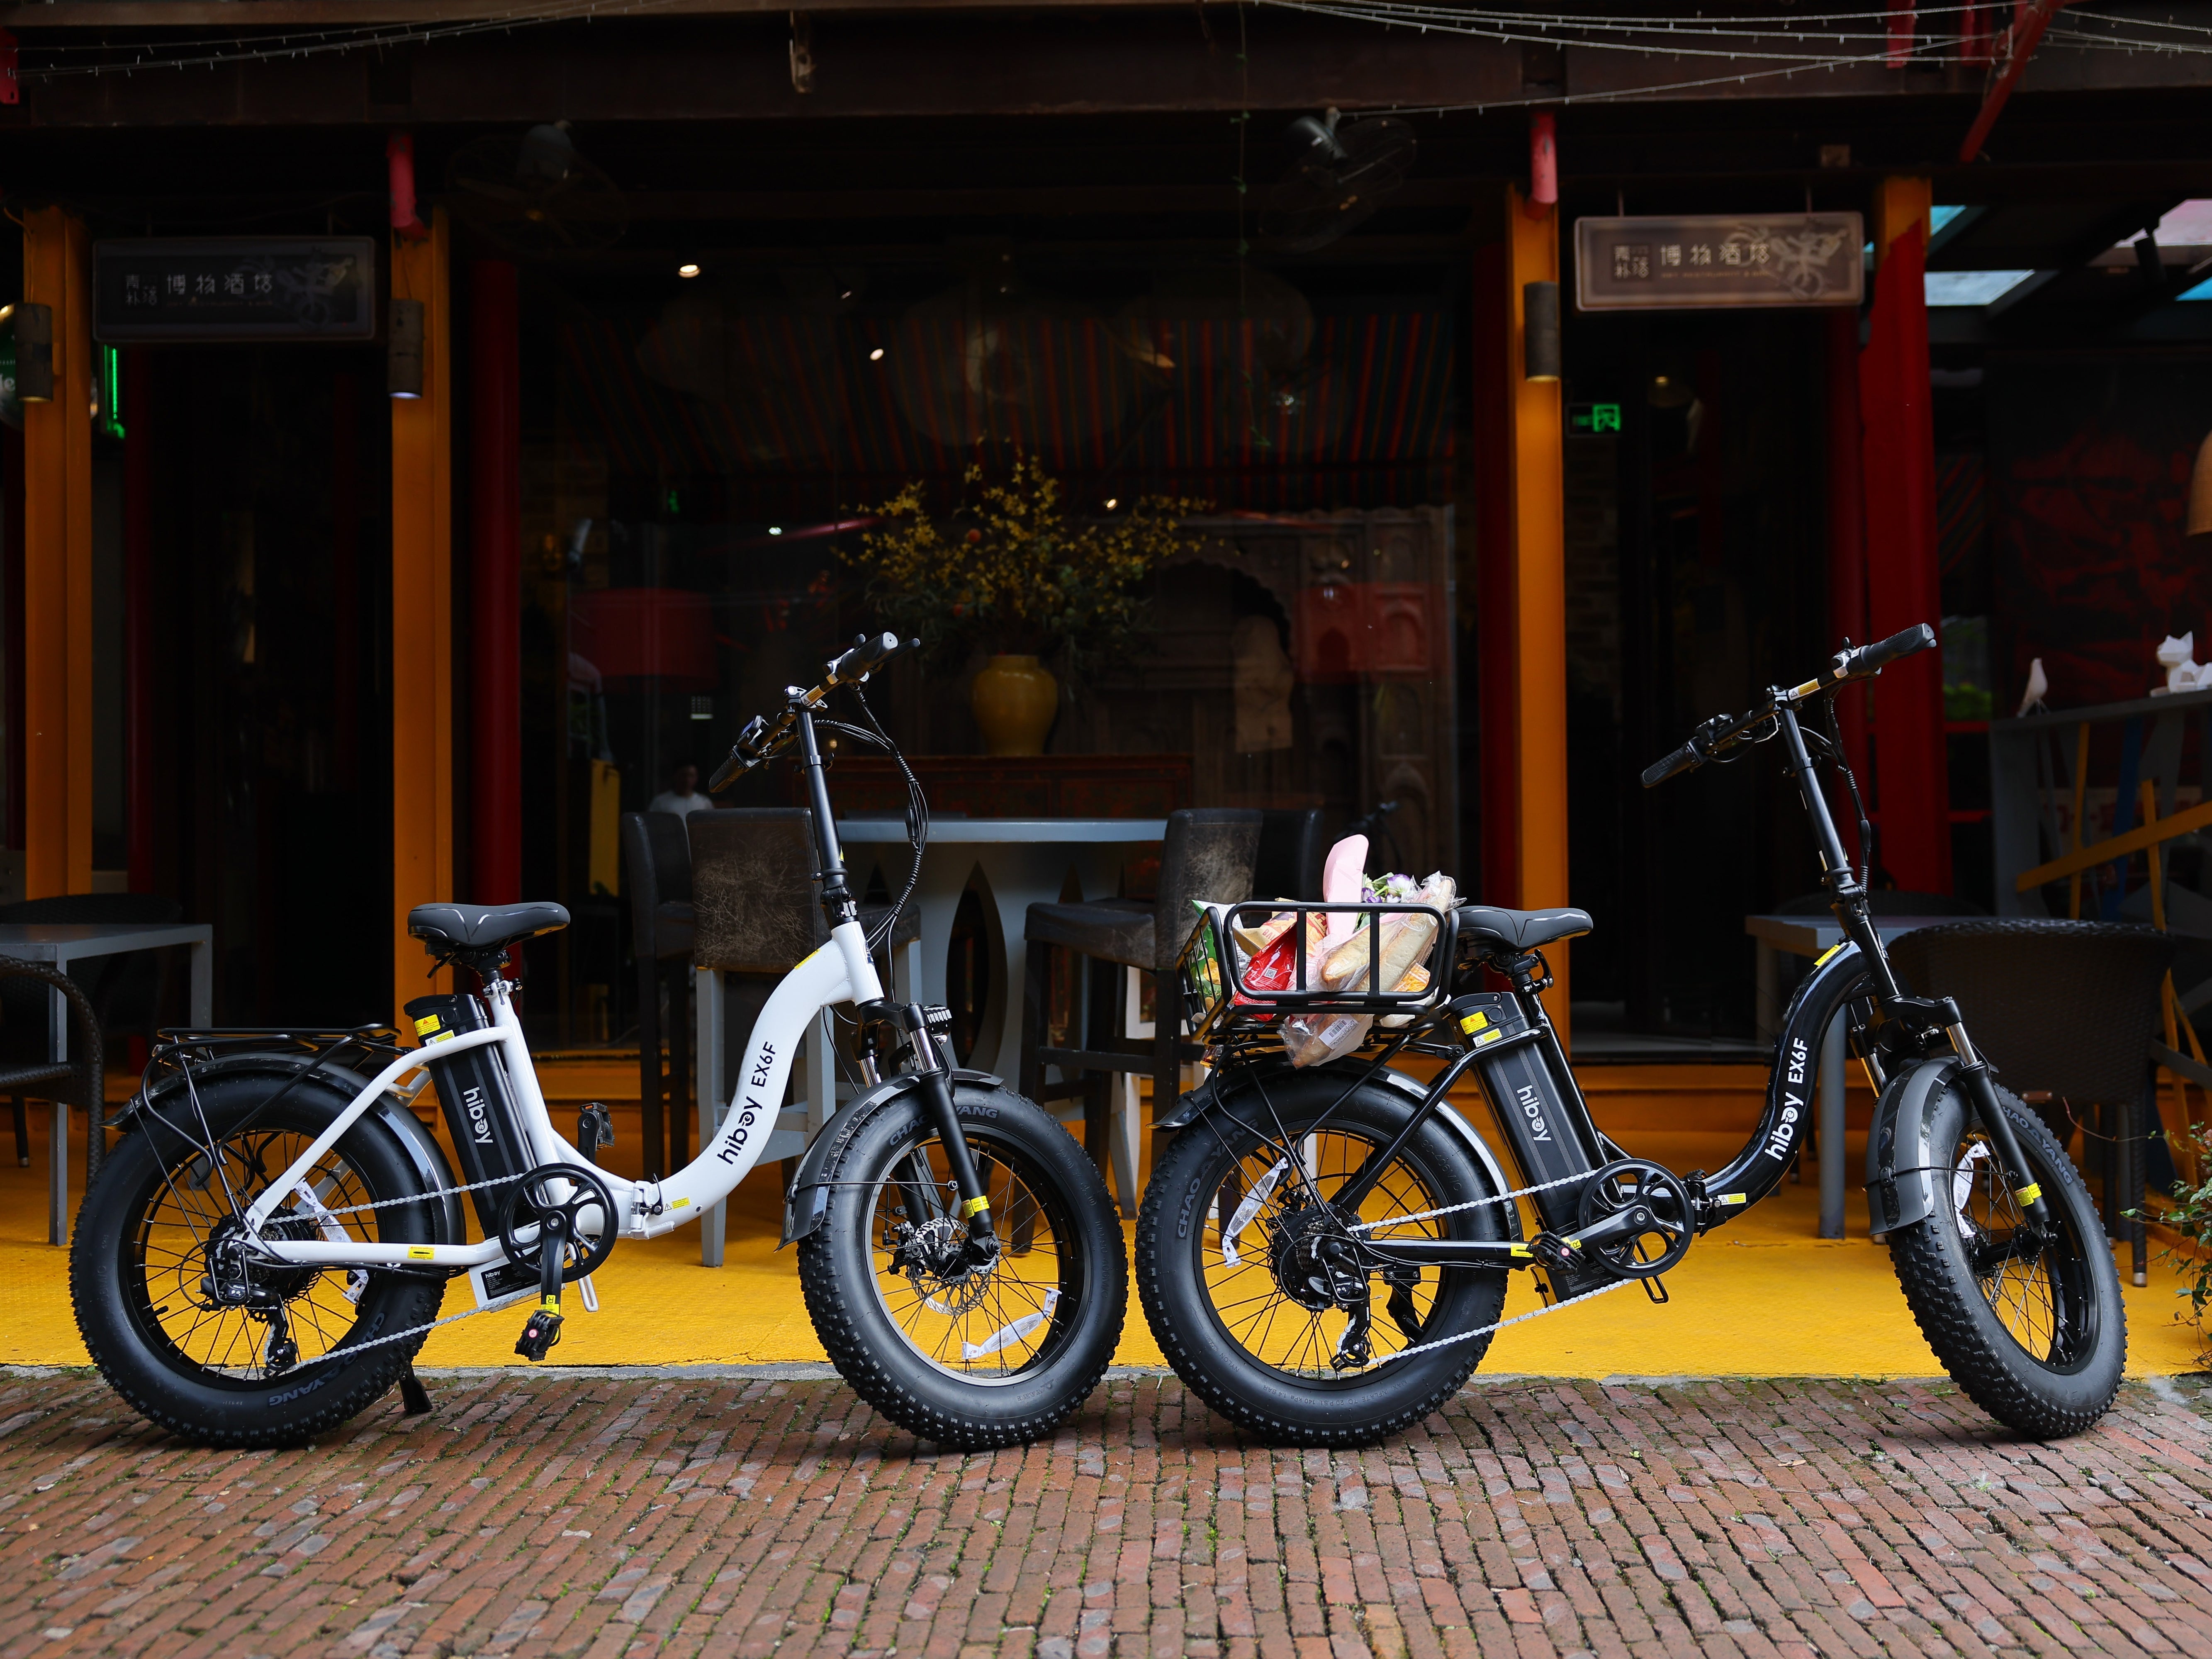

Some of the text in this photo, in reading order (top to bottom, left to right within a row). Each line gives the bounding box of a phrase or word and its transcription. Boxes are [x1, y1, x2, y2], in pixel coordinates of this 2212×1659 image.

[463, 1086, 494, 1144] hiboy
[717, 1041, 778, 1165] hiboy EX6F
[1516, 1085, 1552, 1142] hiboy
[1764, 1037, 1808, 1161] hiboy EX6F
[2003, 1106, 2074, 1185] HAO YANG
[1178, 1118, 1259, 1238] CHAO YANG
[485, 1270, 501, 1279] hiboy
[1219, 1352, 1240, 1373] NYLON
[269, 1378, 325, 1406] YANG
[1263, 1384, 1277, 1395] BAR
[1291, 1394, 1303, 1403] kPa
[1361, 1389, 1389, 1402] INFLATE
